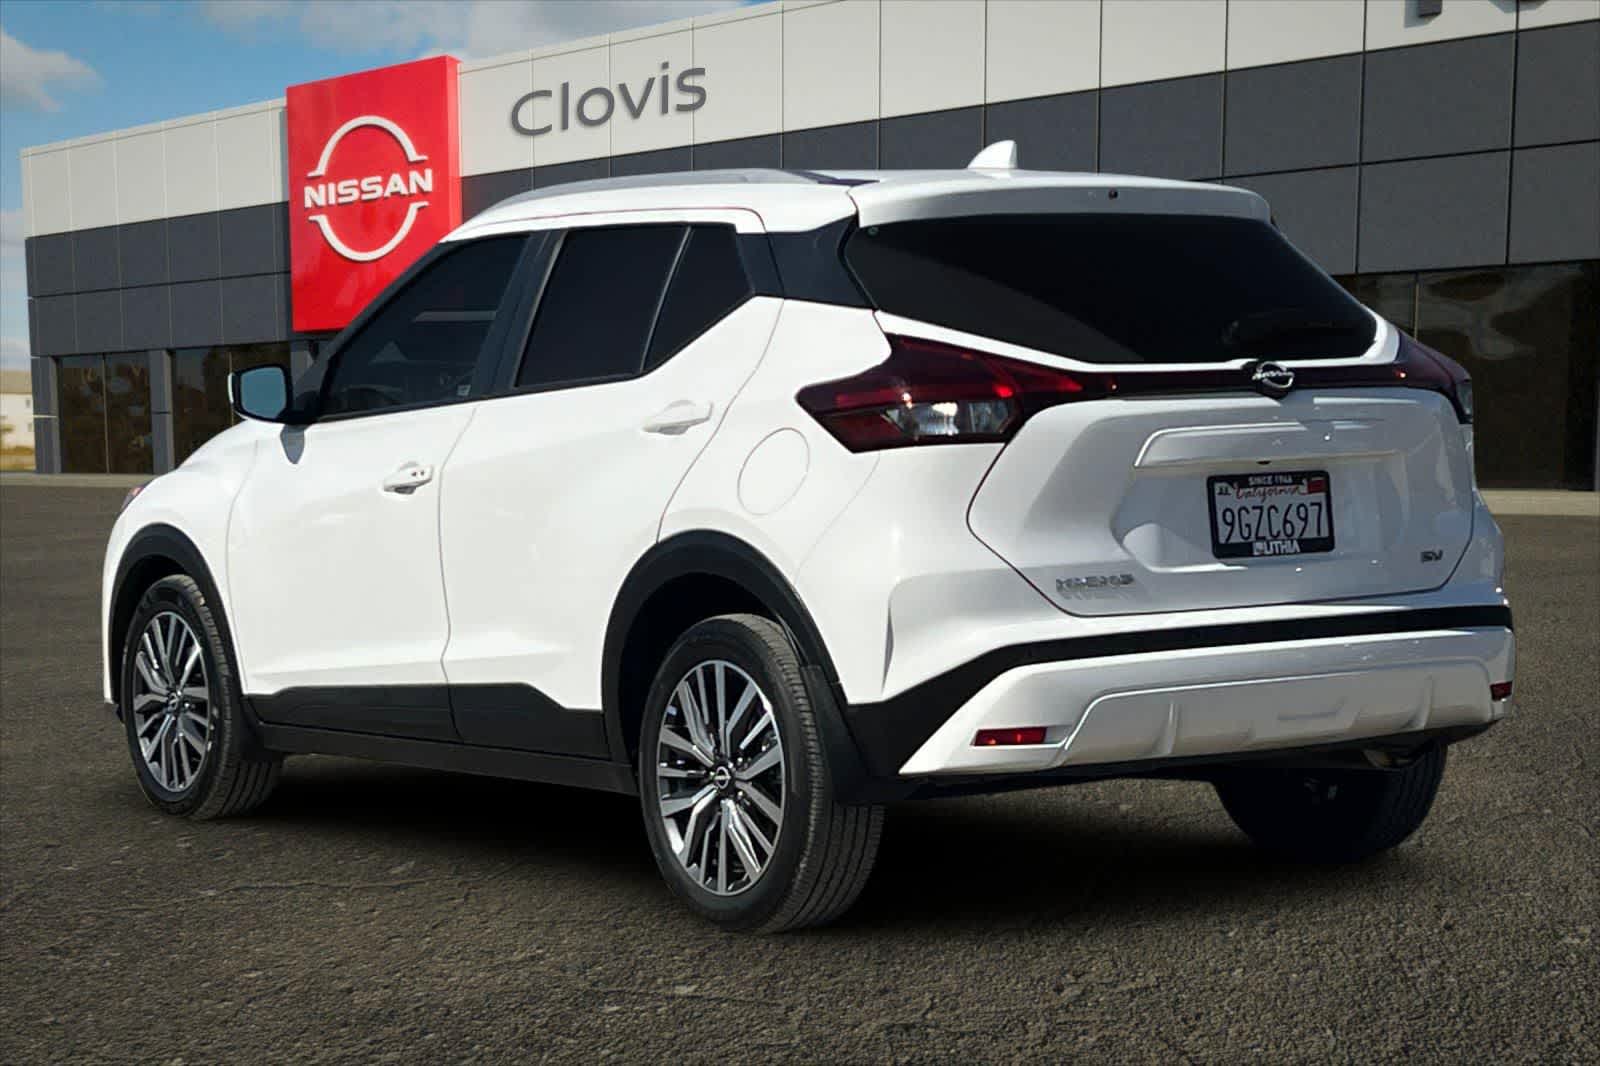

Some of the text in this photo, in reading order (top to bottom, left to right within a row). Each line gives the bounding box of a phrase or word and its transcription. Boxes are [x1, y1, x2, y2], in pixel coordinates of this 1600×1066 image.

[510, 61, 708, 137] Clovis
[303, 168, 434, 209] NISSAN
[1221, 501, 1323, 544] 9GZC697
